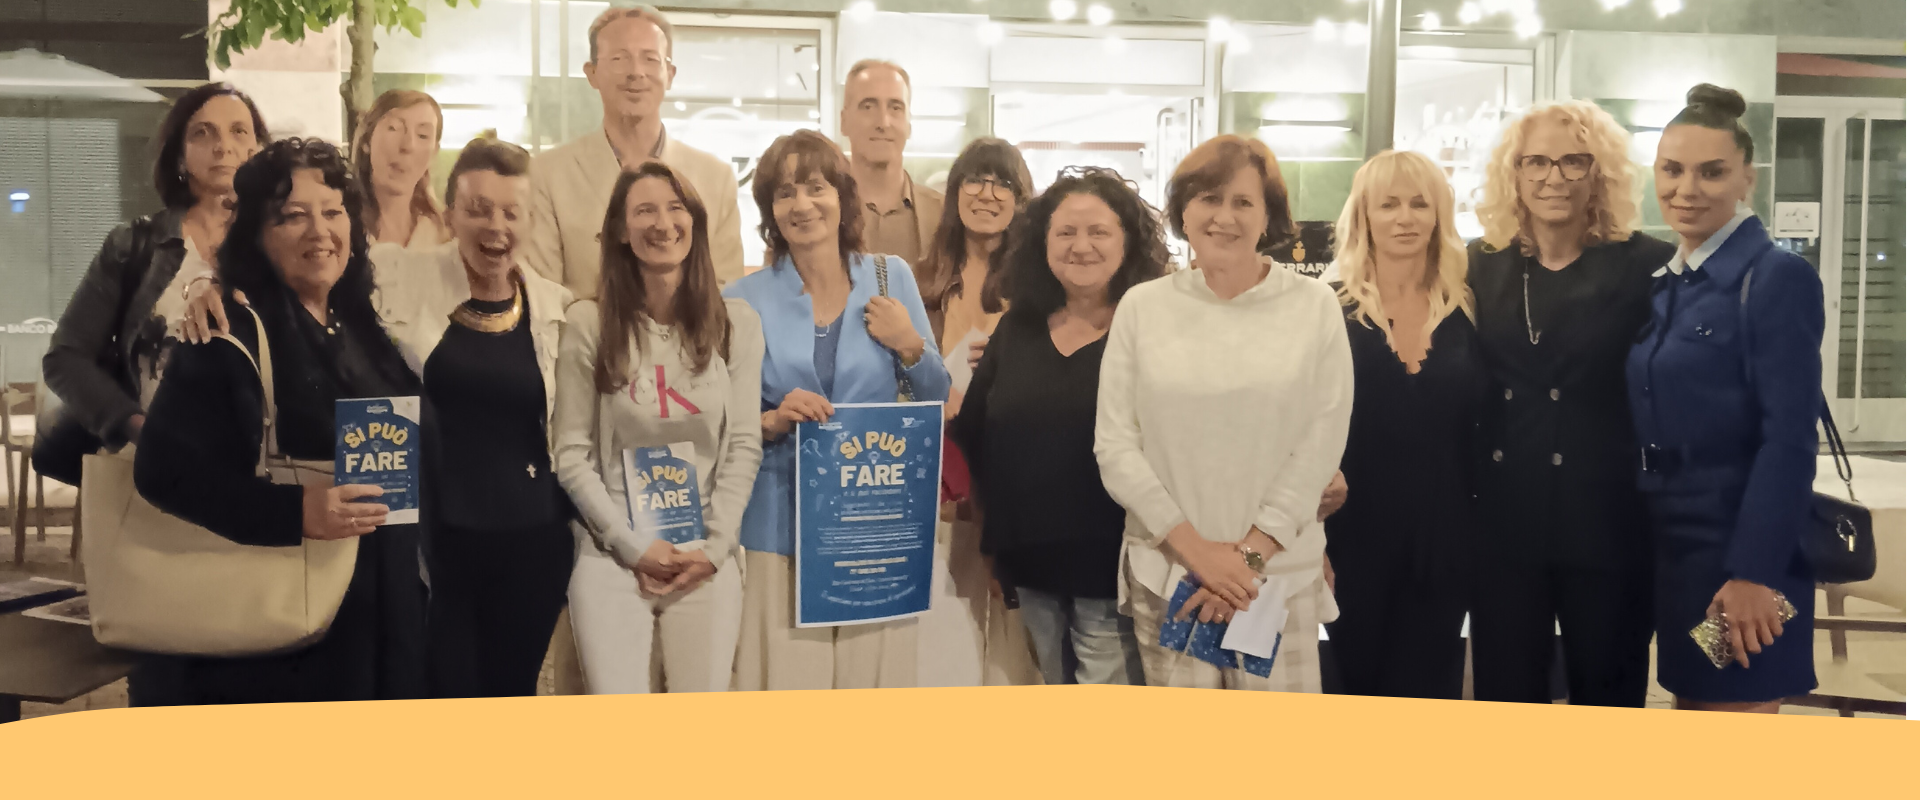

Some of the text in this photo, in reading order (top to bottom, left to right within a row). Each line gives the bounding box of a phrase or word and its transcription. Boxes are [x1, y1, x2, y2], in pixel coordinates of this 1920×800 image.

[344, 422, 409, 449] SI PUÒ
[840, 430, 907, 460] SI PUÒ
[345, 450, 408, 474] FARE
[652, 465, 688, 485] PUÒ
[840, 463, 906, 488] FARE
[637, 488, 692, 512] FARE
